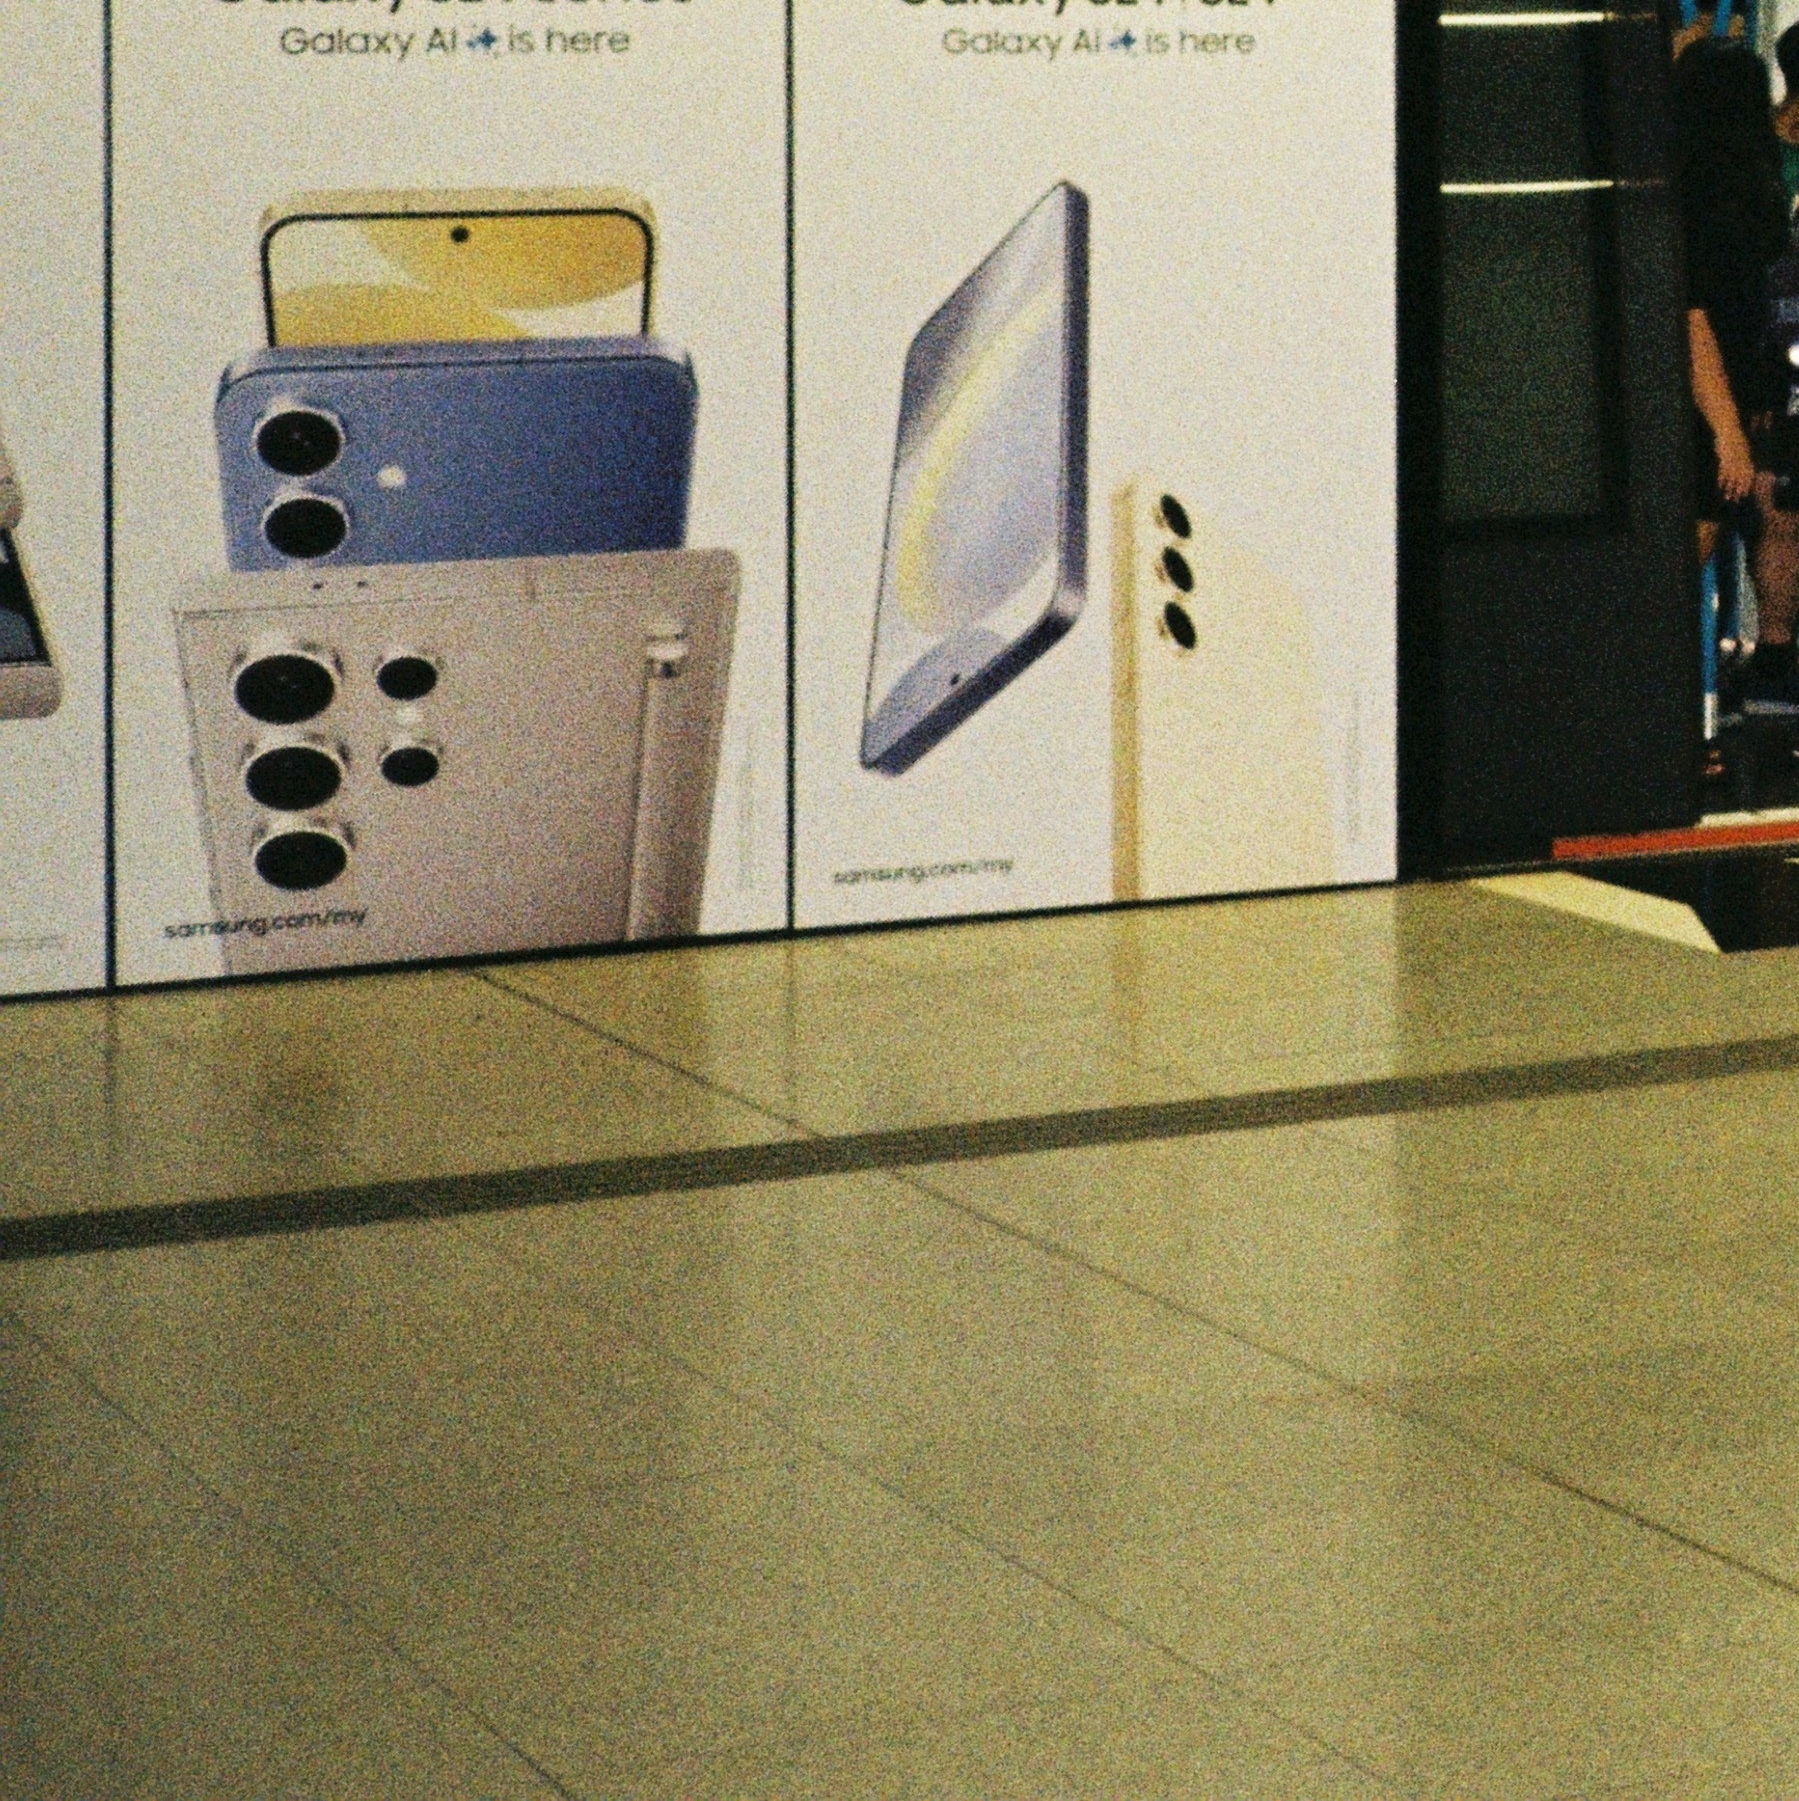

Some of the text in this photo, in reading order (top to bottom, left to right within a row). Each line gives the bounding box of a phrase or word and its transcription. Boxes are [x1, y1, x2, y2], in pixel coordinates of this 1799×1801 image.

[279, 26, 632, 62] Galaxy AI is here
[941, 28, 1063, 61] Galaxy
[1145, 28, 1171, 56] is
[1178, 28, 1257, 56] here
[163, 905, 369, 939] samsung.com/my
